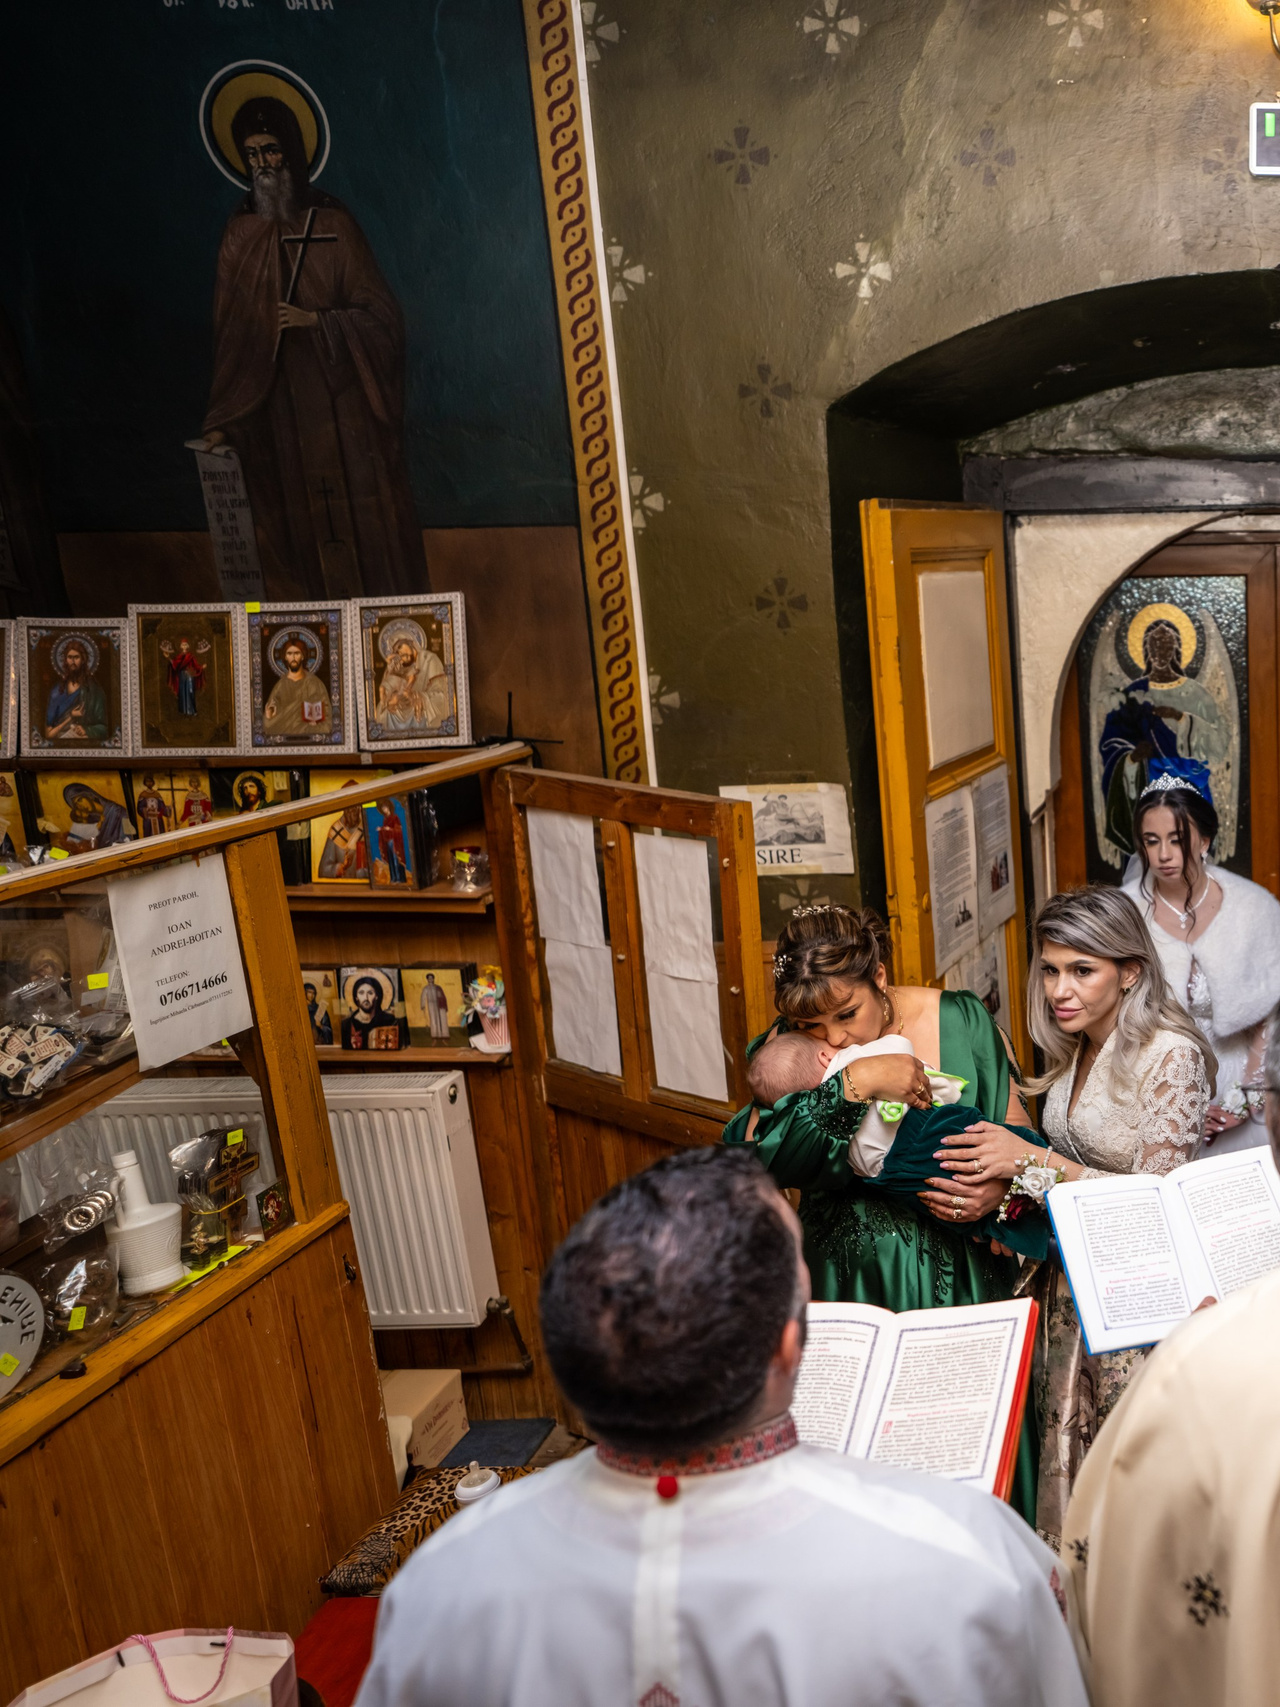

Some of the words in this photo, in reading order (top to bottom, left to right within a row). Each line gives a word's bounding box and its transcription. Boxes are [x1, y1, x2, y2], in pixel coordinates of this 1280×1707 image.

[757, 848, 803, 865] SIRE
[148, 898, 172, 911] PREOT
[167, 919, 192, 935] IOAN
[150, 926, 223, 958] ANDREI-BOITAN
[155, 970, 190, 987] TELEFON:
[159, 970, 228, 1007] 0766714666
